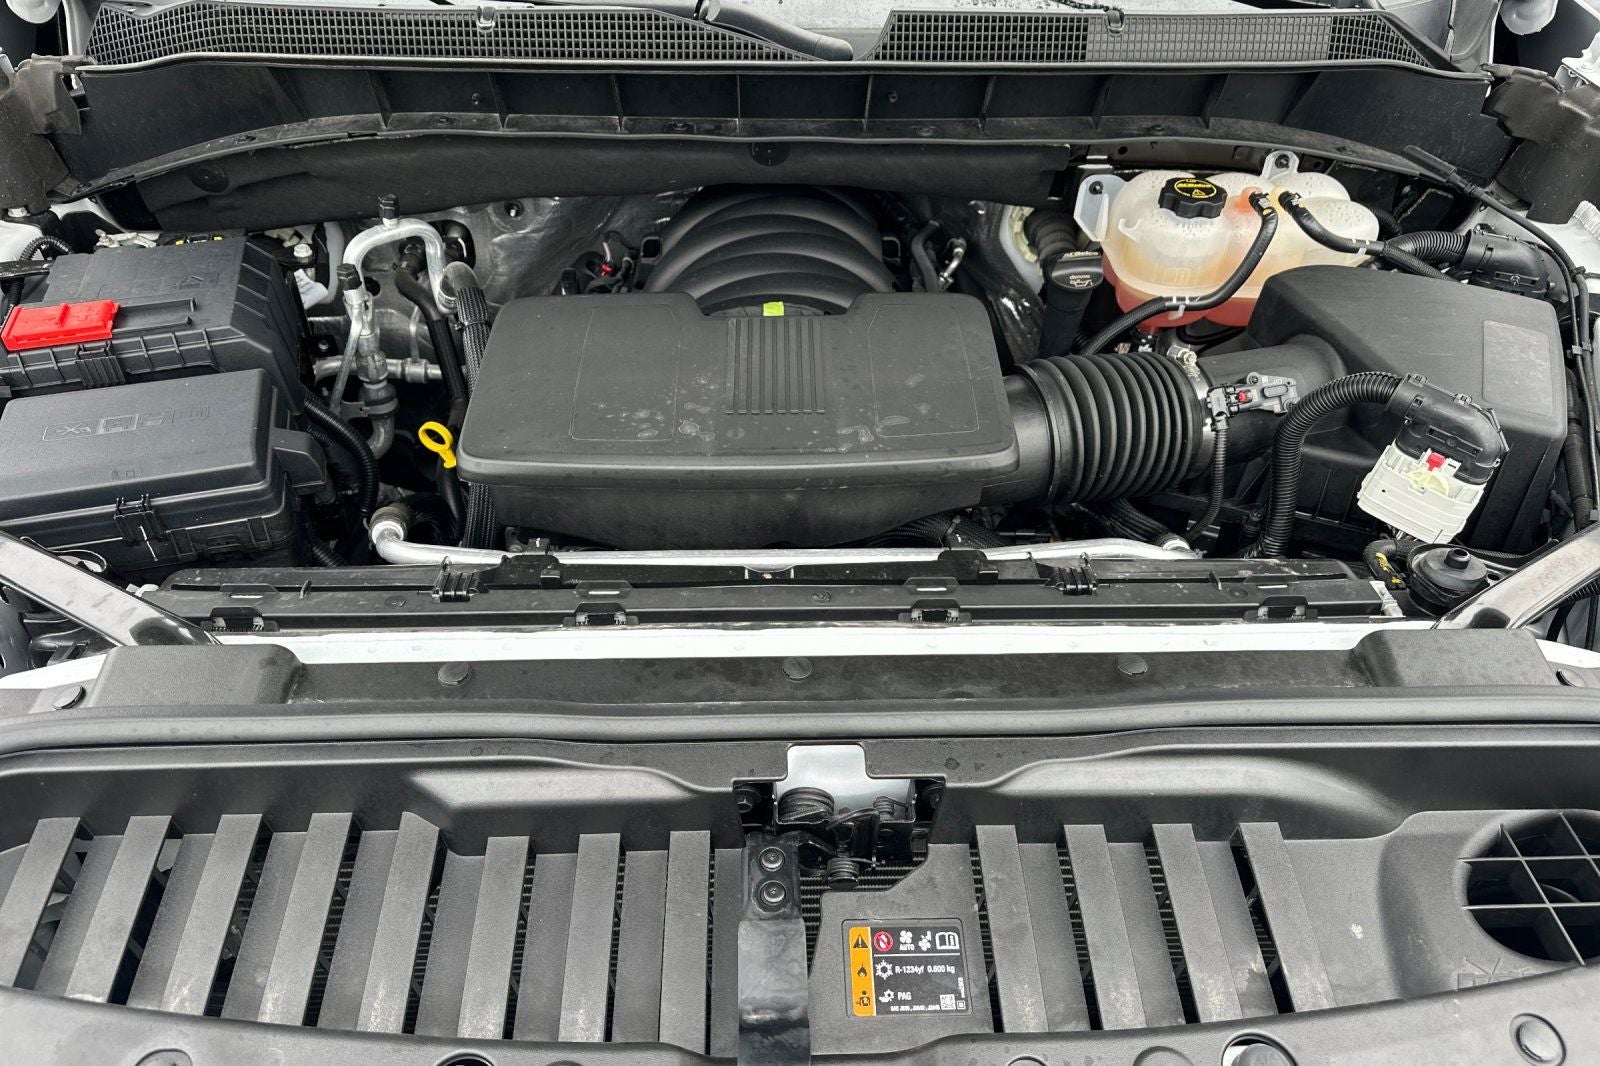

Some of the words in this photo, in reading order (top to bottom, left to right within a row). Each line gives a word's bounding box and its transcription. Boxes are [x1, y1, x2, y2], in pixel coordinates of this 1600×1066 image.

[899, 943, 915, 951] AUTO
[895, 965, 924, 975] R-1234yf
[946, 964, 956, 974] kg
[897, 992, 912, 1001] PAG
